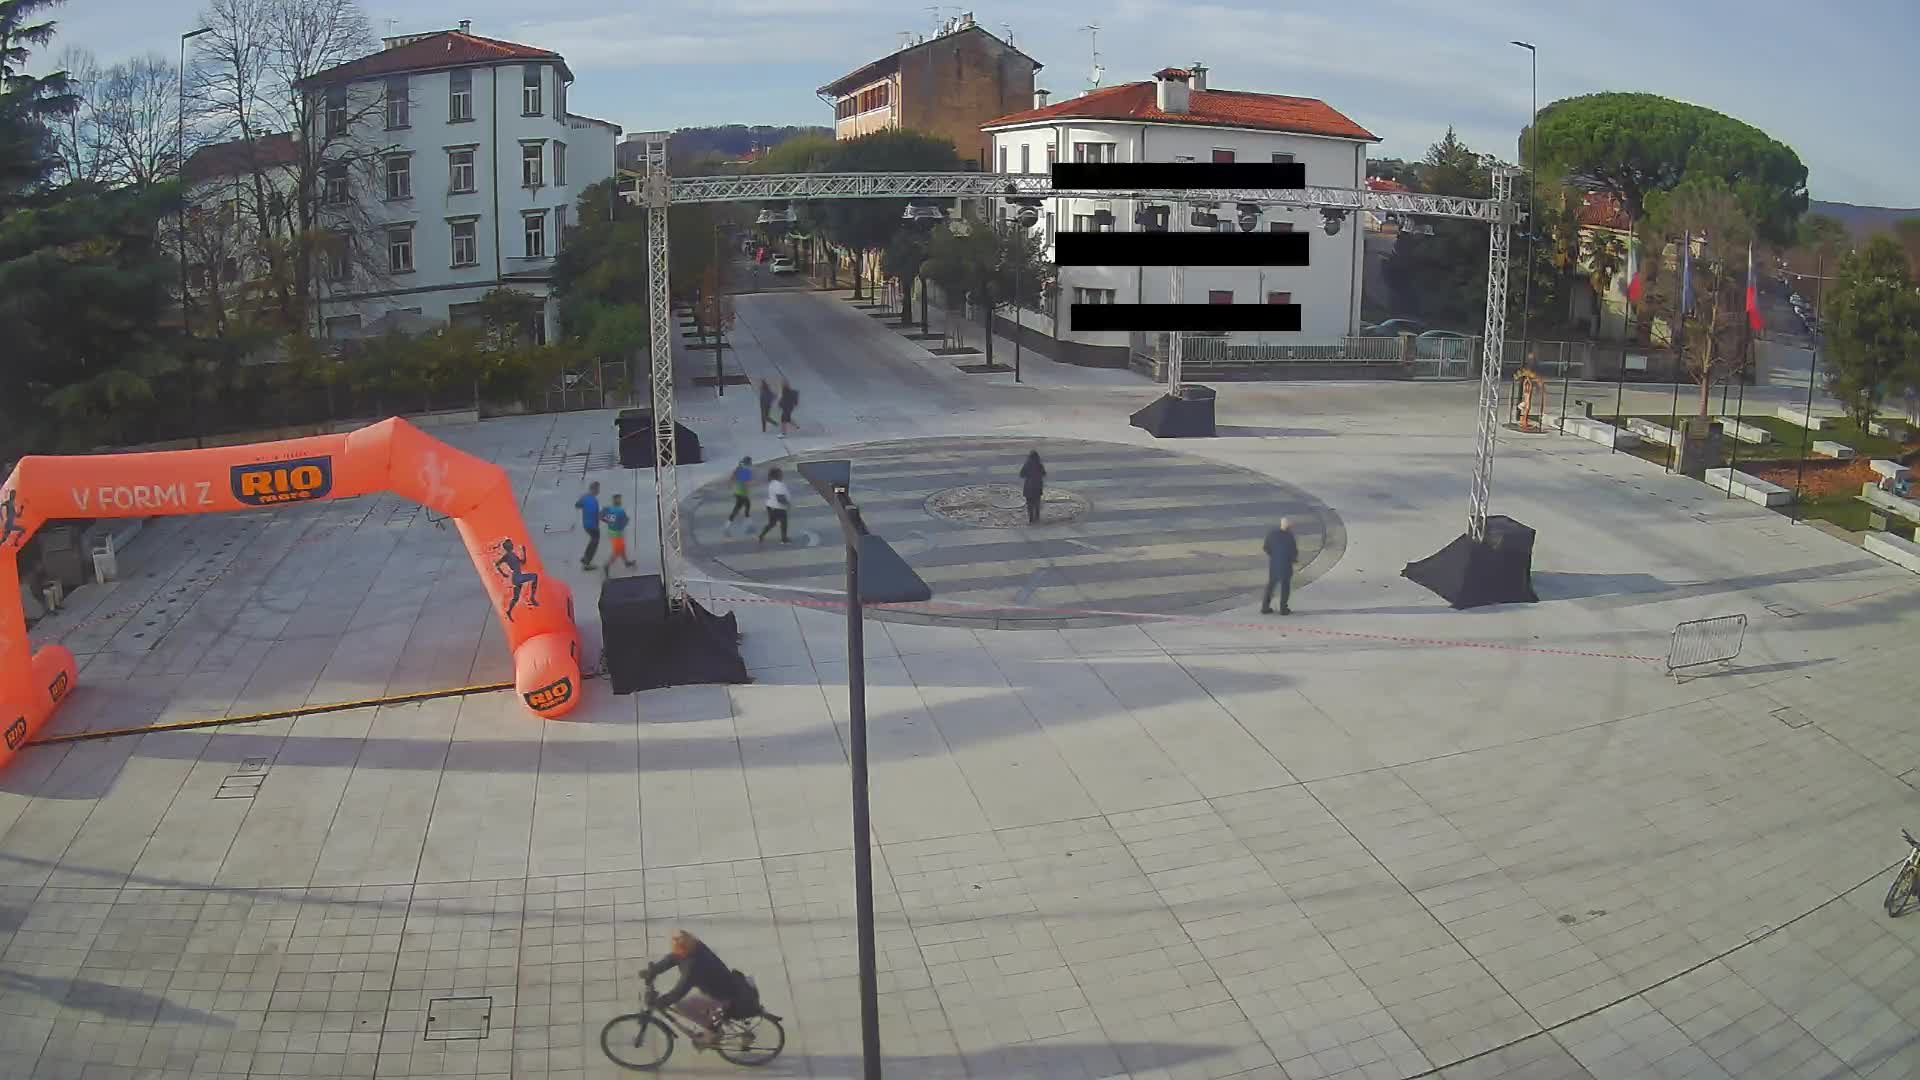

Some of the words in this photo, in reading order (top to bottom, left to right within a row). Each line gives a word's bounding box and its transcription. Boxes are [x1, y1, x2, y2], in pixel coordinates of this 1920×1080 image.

[72, 487, 91, 511] V
[98, 484, 187, 509] FORMI
[195, 481, 214, 505] Z
[242, 466, 323, 497] RIO
[531, 683, 569, 706] RIO
